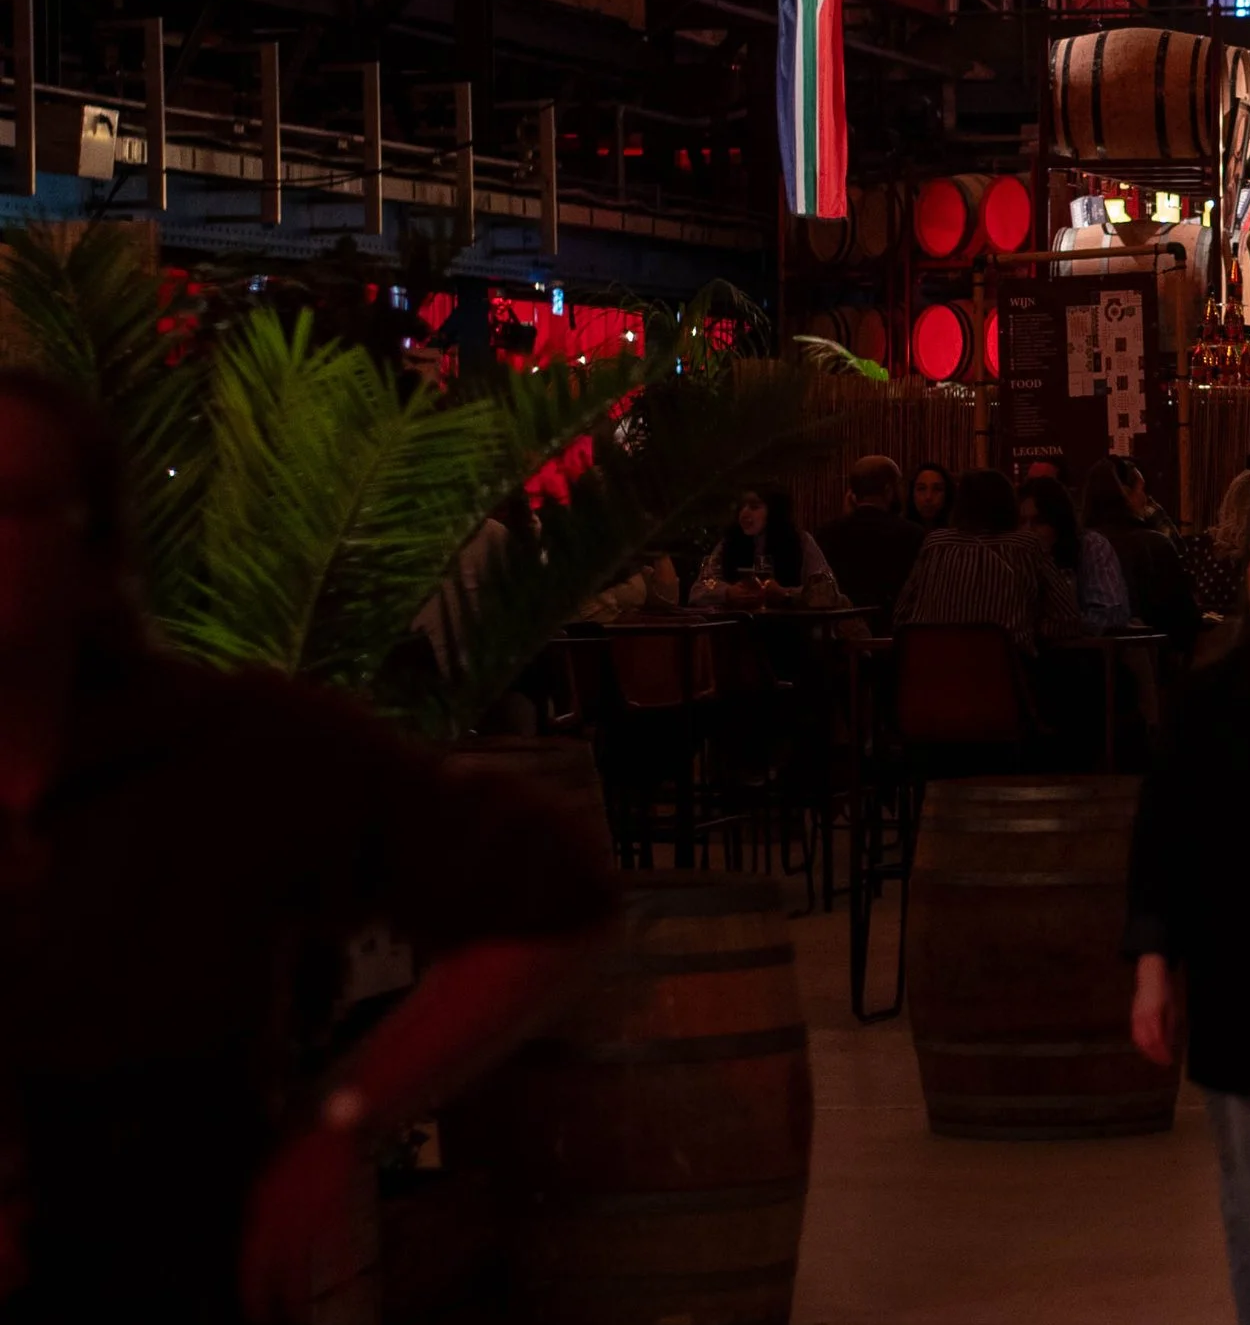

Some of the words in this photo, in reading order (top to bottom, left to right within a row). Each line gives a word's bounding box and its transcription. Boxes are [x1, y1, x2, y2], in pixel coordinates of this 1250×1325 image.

[1009, 297, 1036, 310] WIJN
[1010, 377, 1043, 390] FOOD
[1012, 444, 1064, 457] LEGENDA
